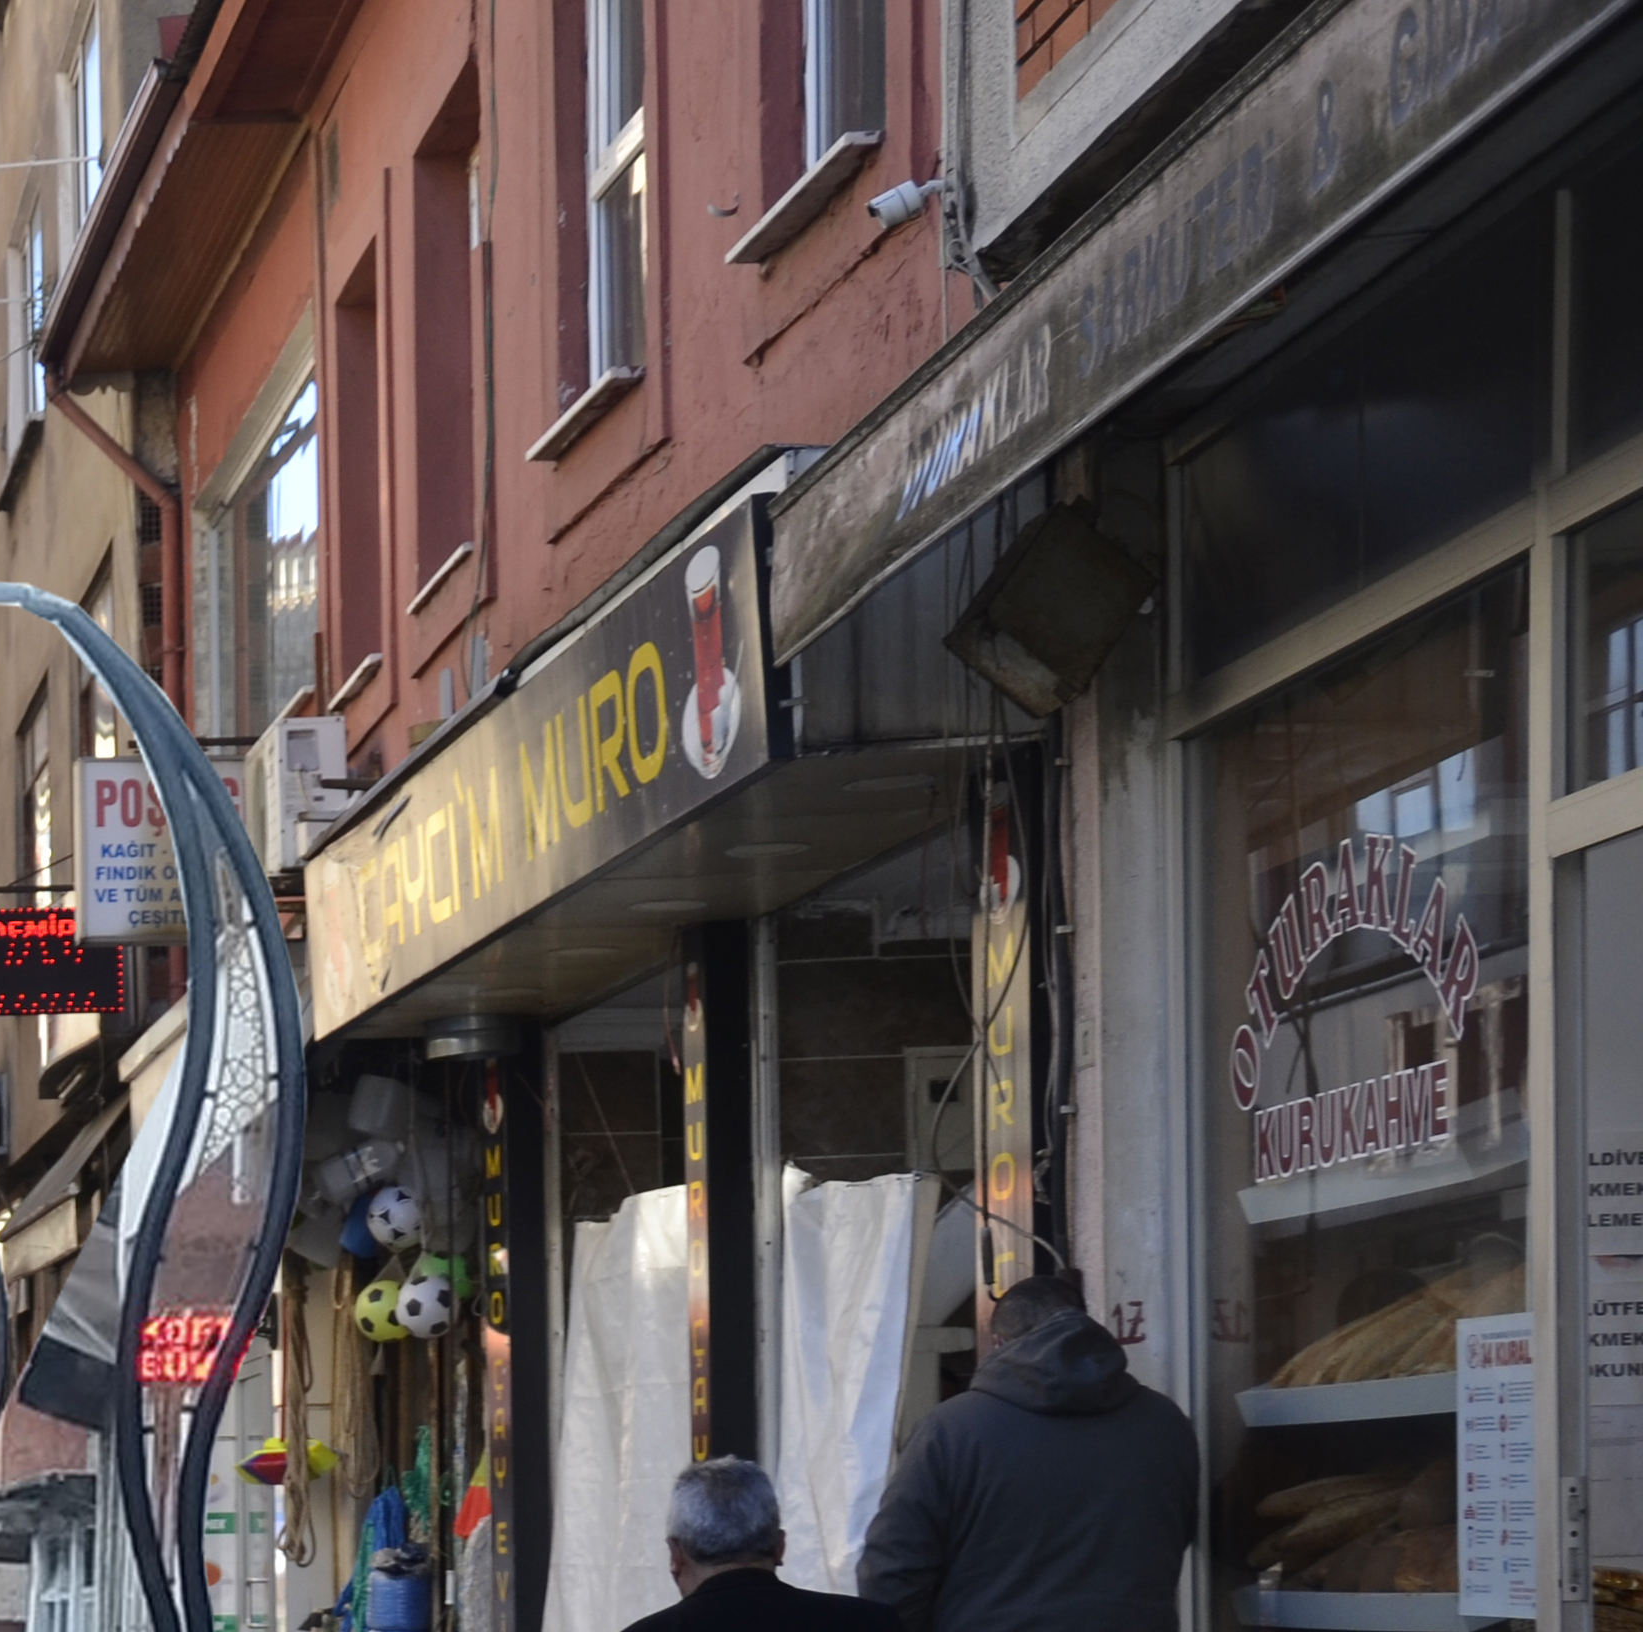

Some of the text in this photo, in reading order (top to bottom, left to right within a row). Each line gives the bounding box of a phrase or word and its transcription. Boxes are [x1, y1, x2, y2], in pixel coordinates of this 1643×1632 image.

[1309, 78, 1341, 202] &
[519, 641, 667, 861] MURO
[95, 866, 156, 881] FINDIK
[95, 888, 118, 903] VE
[124, 885, 163, 903] TÜM
[101, 841, 156, 858] KAĞIT
[128, 908, 187, 928] ÇEŞİT
[1229, 833, 1479, 1111] OTURAKLAR
[987, 932, 1014, 1200] MURO
[1254, 1059, 1449, 1183] KURUKAHVE
[685, 1062, 704, 1279] MURO
[485, 1144, 506, 1326] MURO
